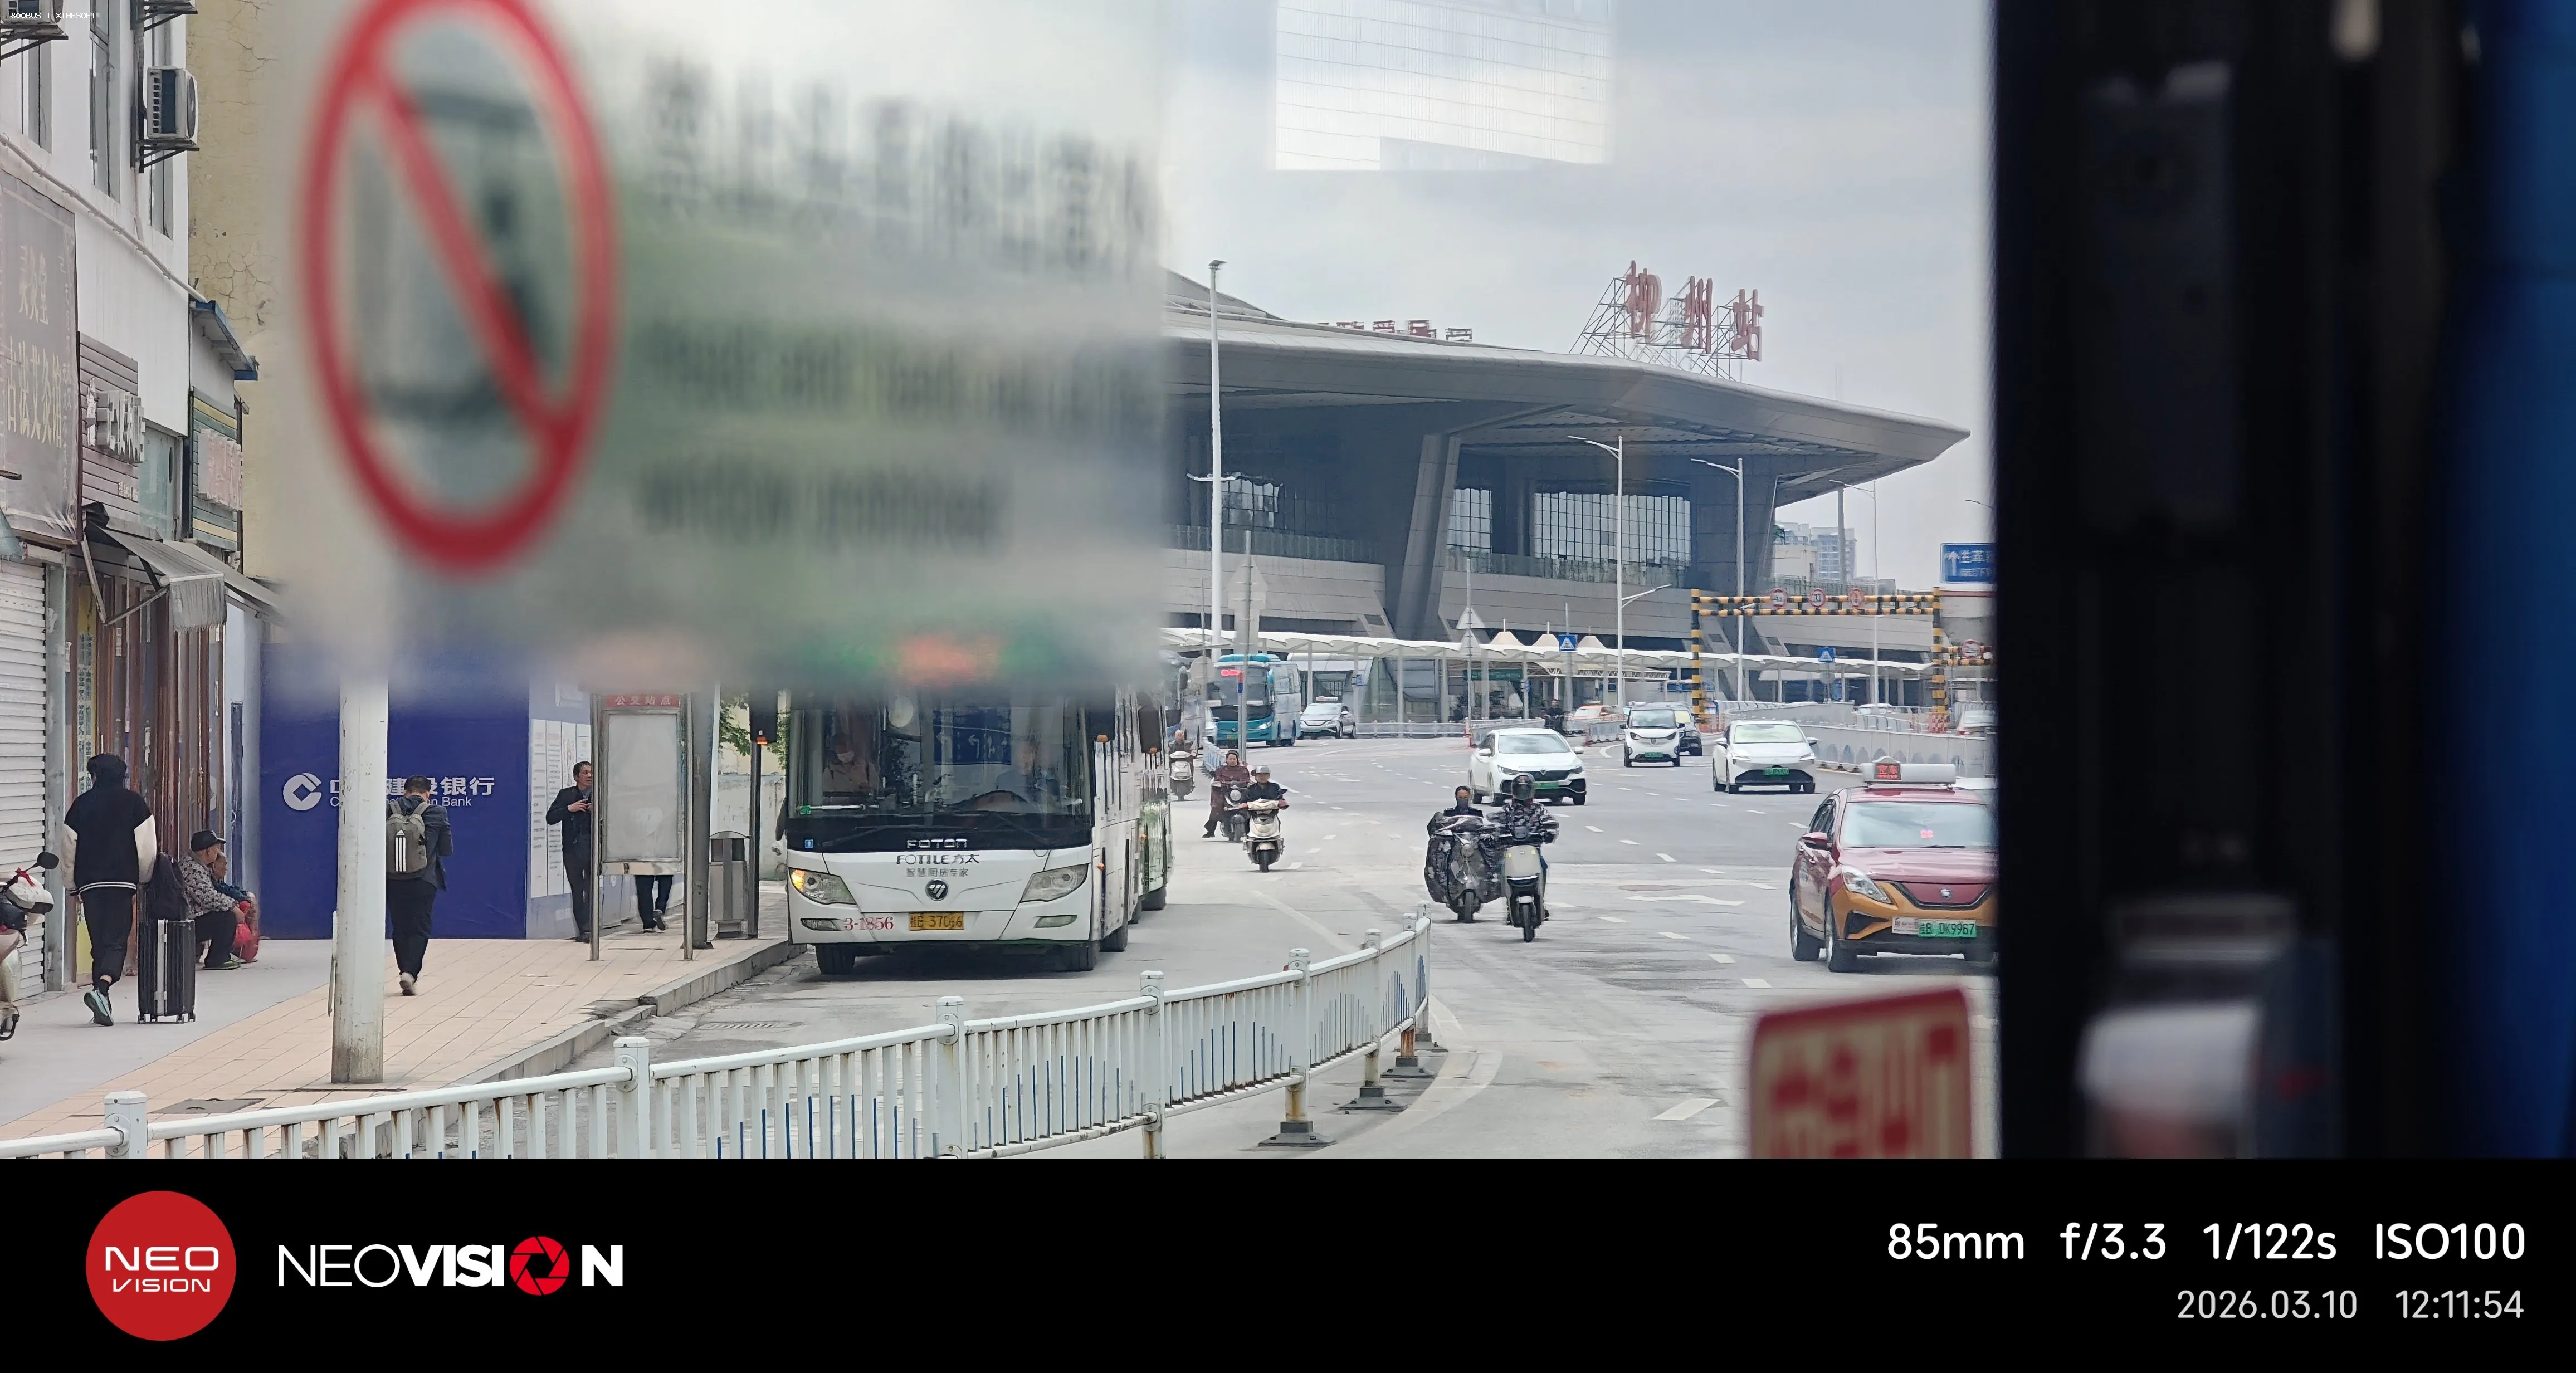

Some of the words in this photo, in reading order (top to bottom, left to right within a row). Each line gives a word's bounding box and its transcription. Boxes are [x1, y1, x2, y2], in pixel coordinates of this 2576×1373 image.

[442, 797, 472, 807] Bank
[906, 838, 968, 849] FOTON
[843, 916, 894, 931] 3-1856
